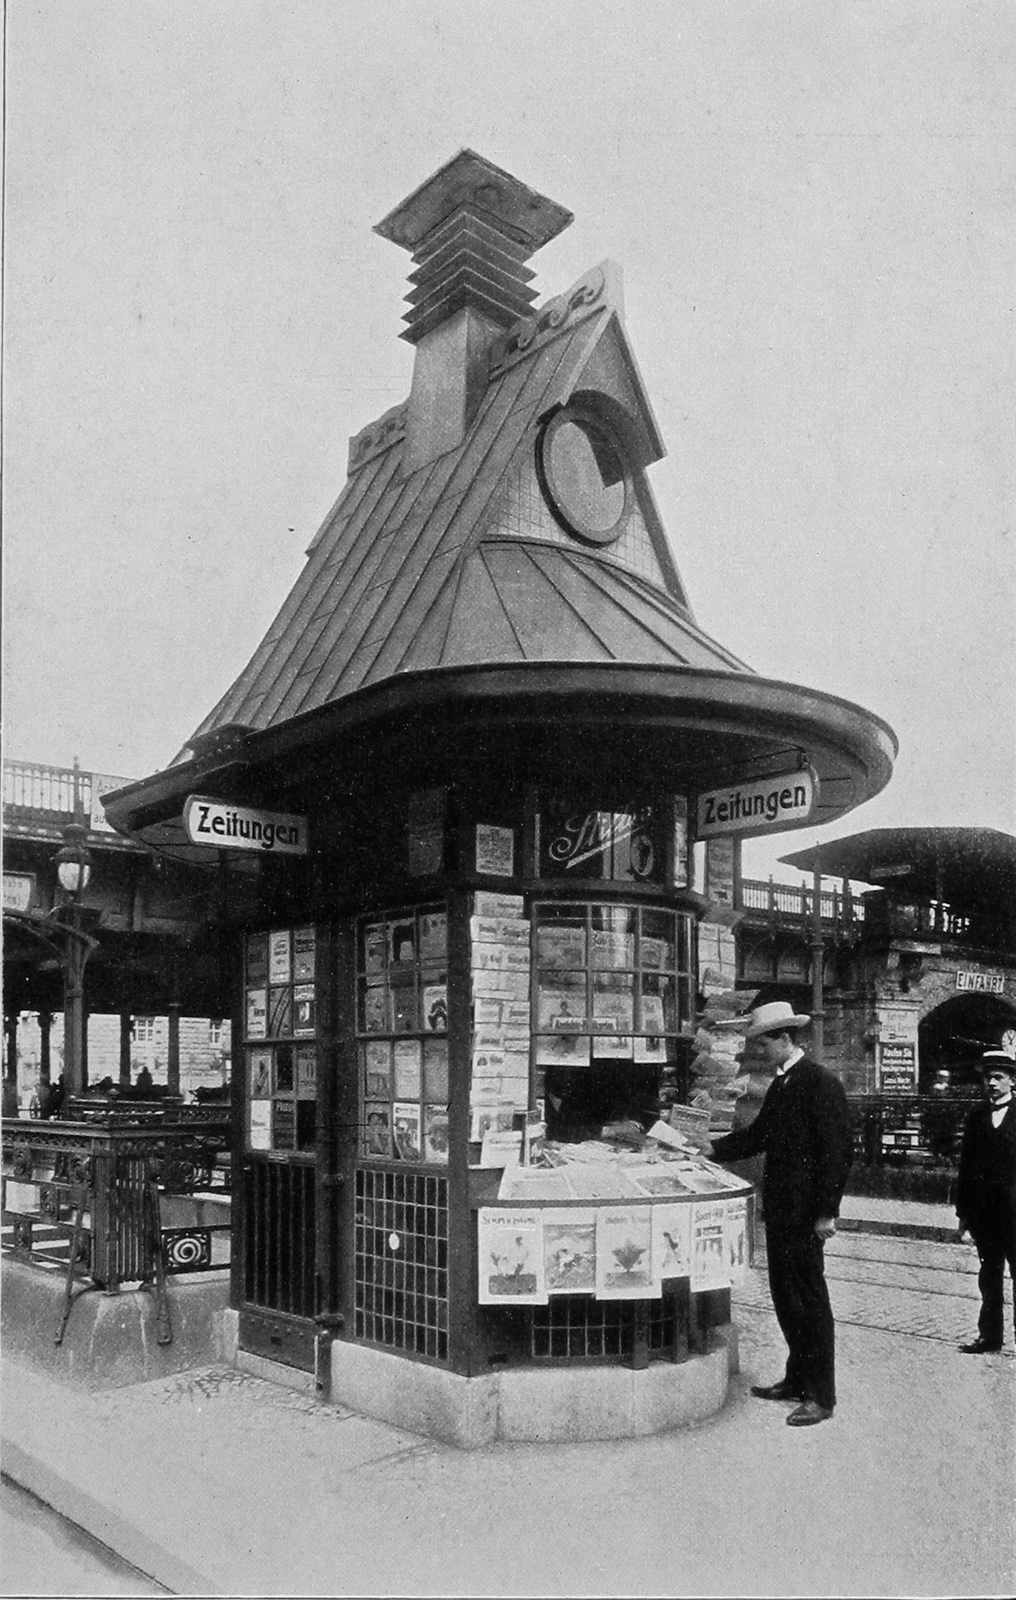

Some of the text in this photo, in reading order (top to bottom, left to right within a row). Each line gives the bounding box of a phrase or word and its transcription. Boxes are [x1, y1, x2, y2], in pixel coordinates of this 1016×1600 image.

[704, 786, 807, 824] Zeitungen
[197, 806, 299, 849] Zeitungen
[958, 973, 1003, 991] EINFAHRT
